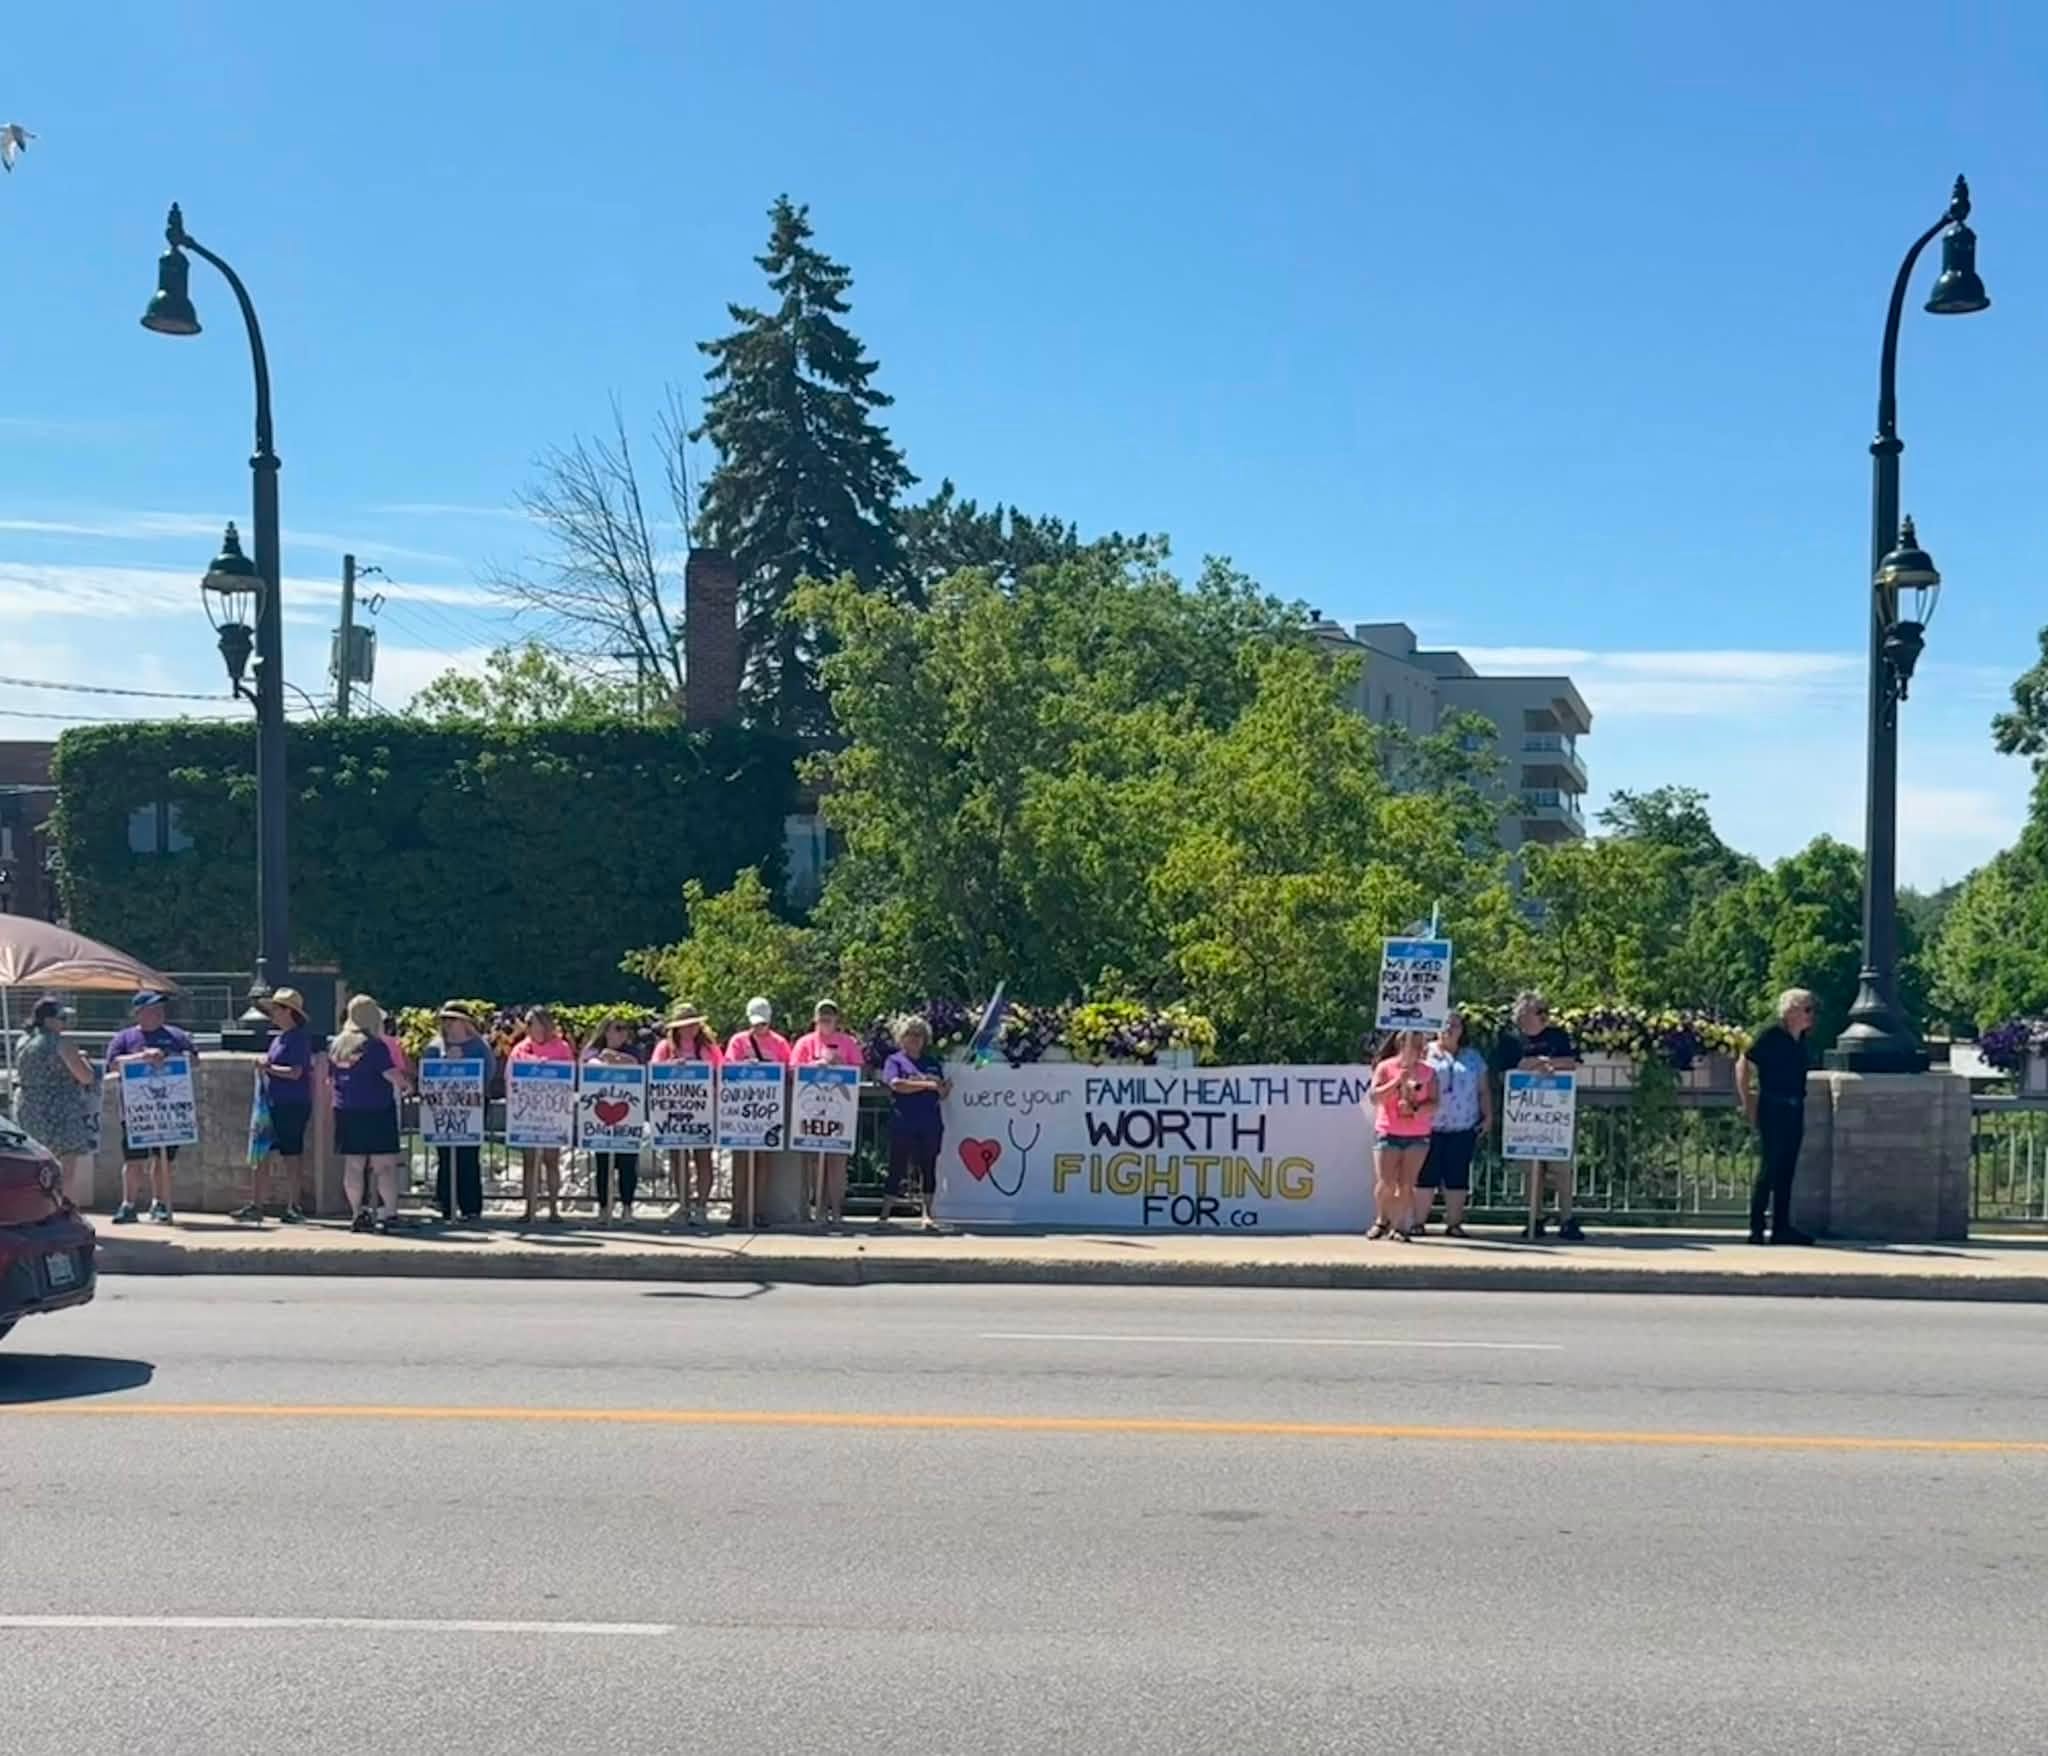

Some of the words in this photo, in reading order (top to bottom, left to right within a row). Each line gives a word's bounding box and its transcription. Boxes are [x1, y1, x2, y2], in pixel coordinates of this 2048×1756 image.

[649, 1083, 708, 1098] MISSING
[1020, 1089, 1072, 1116] your
[1085, 1077, 1179, 1105] FAMILY
[1183, 1077, 1288, 1105] HEALTH
[1507, 1089, 1552, 1108] PAUL
[651, 1100, 706, 1111] PERSON
[742, 1102, 780, 1120] STOP
[1506, 1109, 1570, 1127] VICKERS
[1086, 1110, 1266, 1153] WORTH
[1053, 1153, 1316, 1201] FIGHTING
